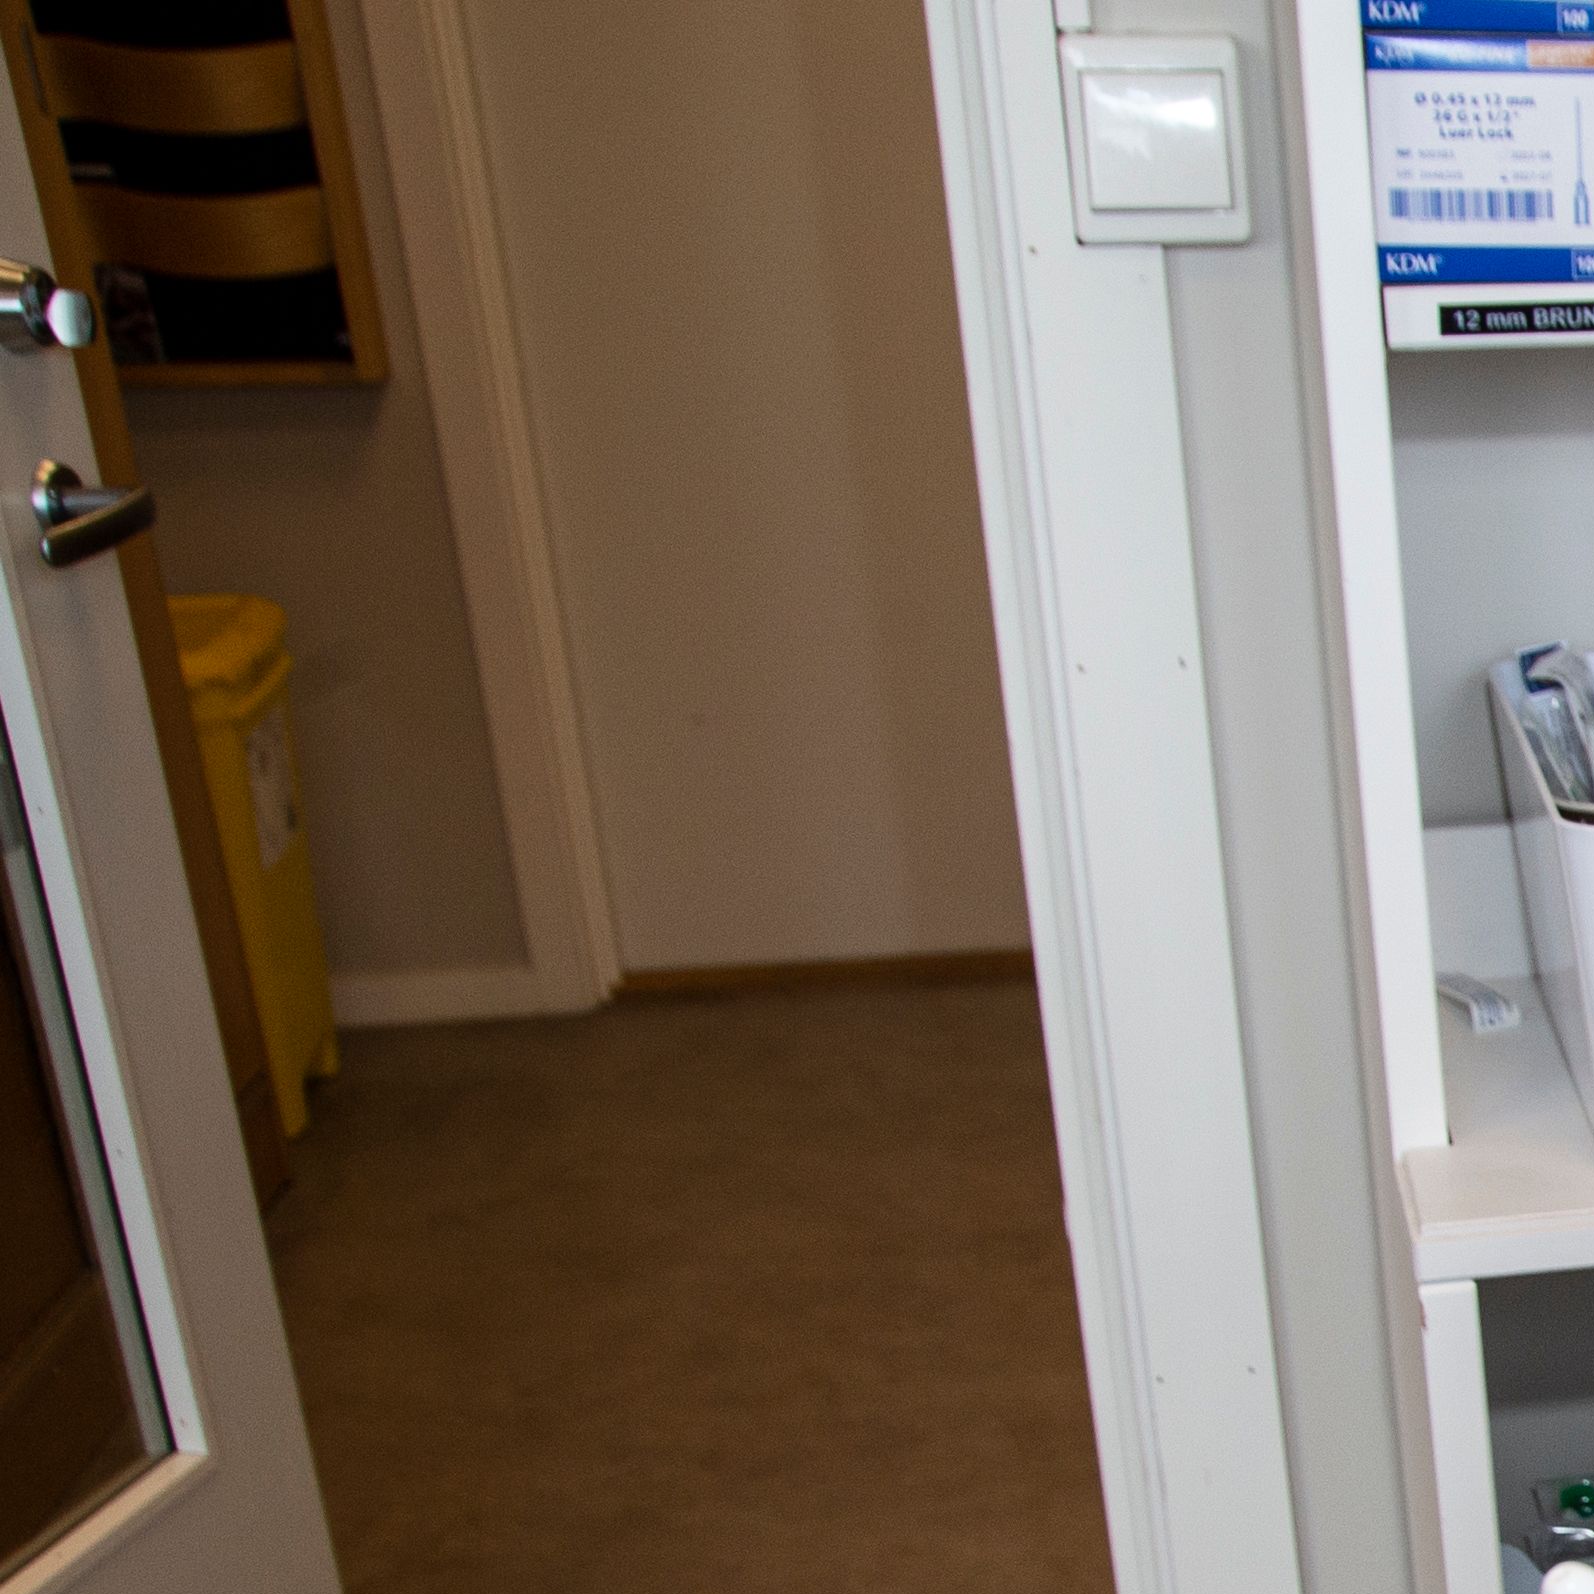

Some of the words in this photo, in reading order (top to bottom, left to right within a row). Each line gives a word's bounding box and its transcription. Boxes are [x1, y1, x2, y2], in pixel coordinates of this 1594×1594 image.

[1368, 0, 1421, 22] KDM
[1386, 252, 1438, 275] KDM
[1453, 308, 1481, 331] 12
[1486, 309, 1528, 331] mm
